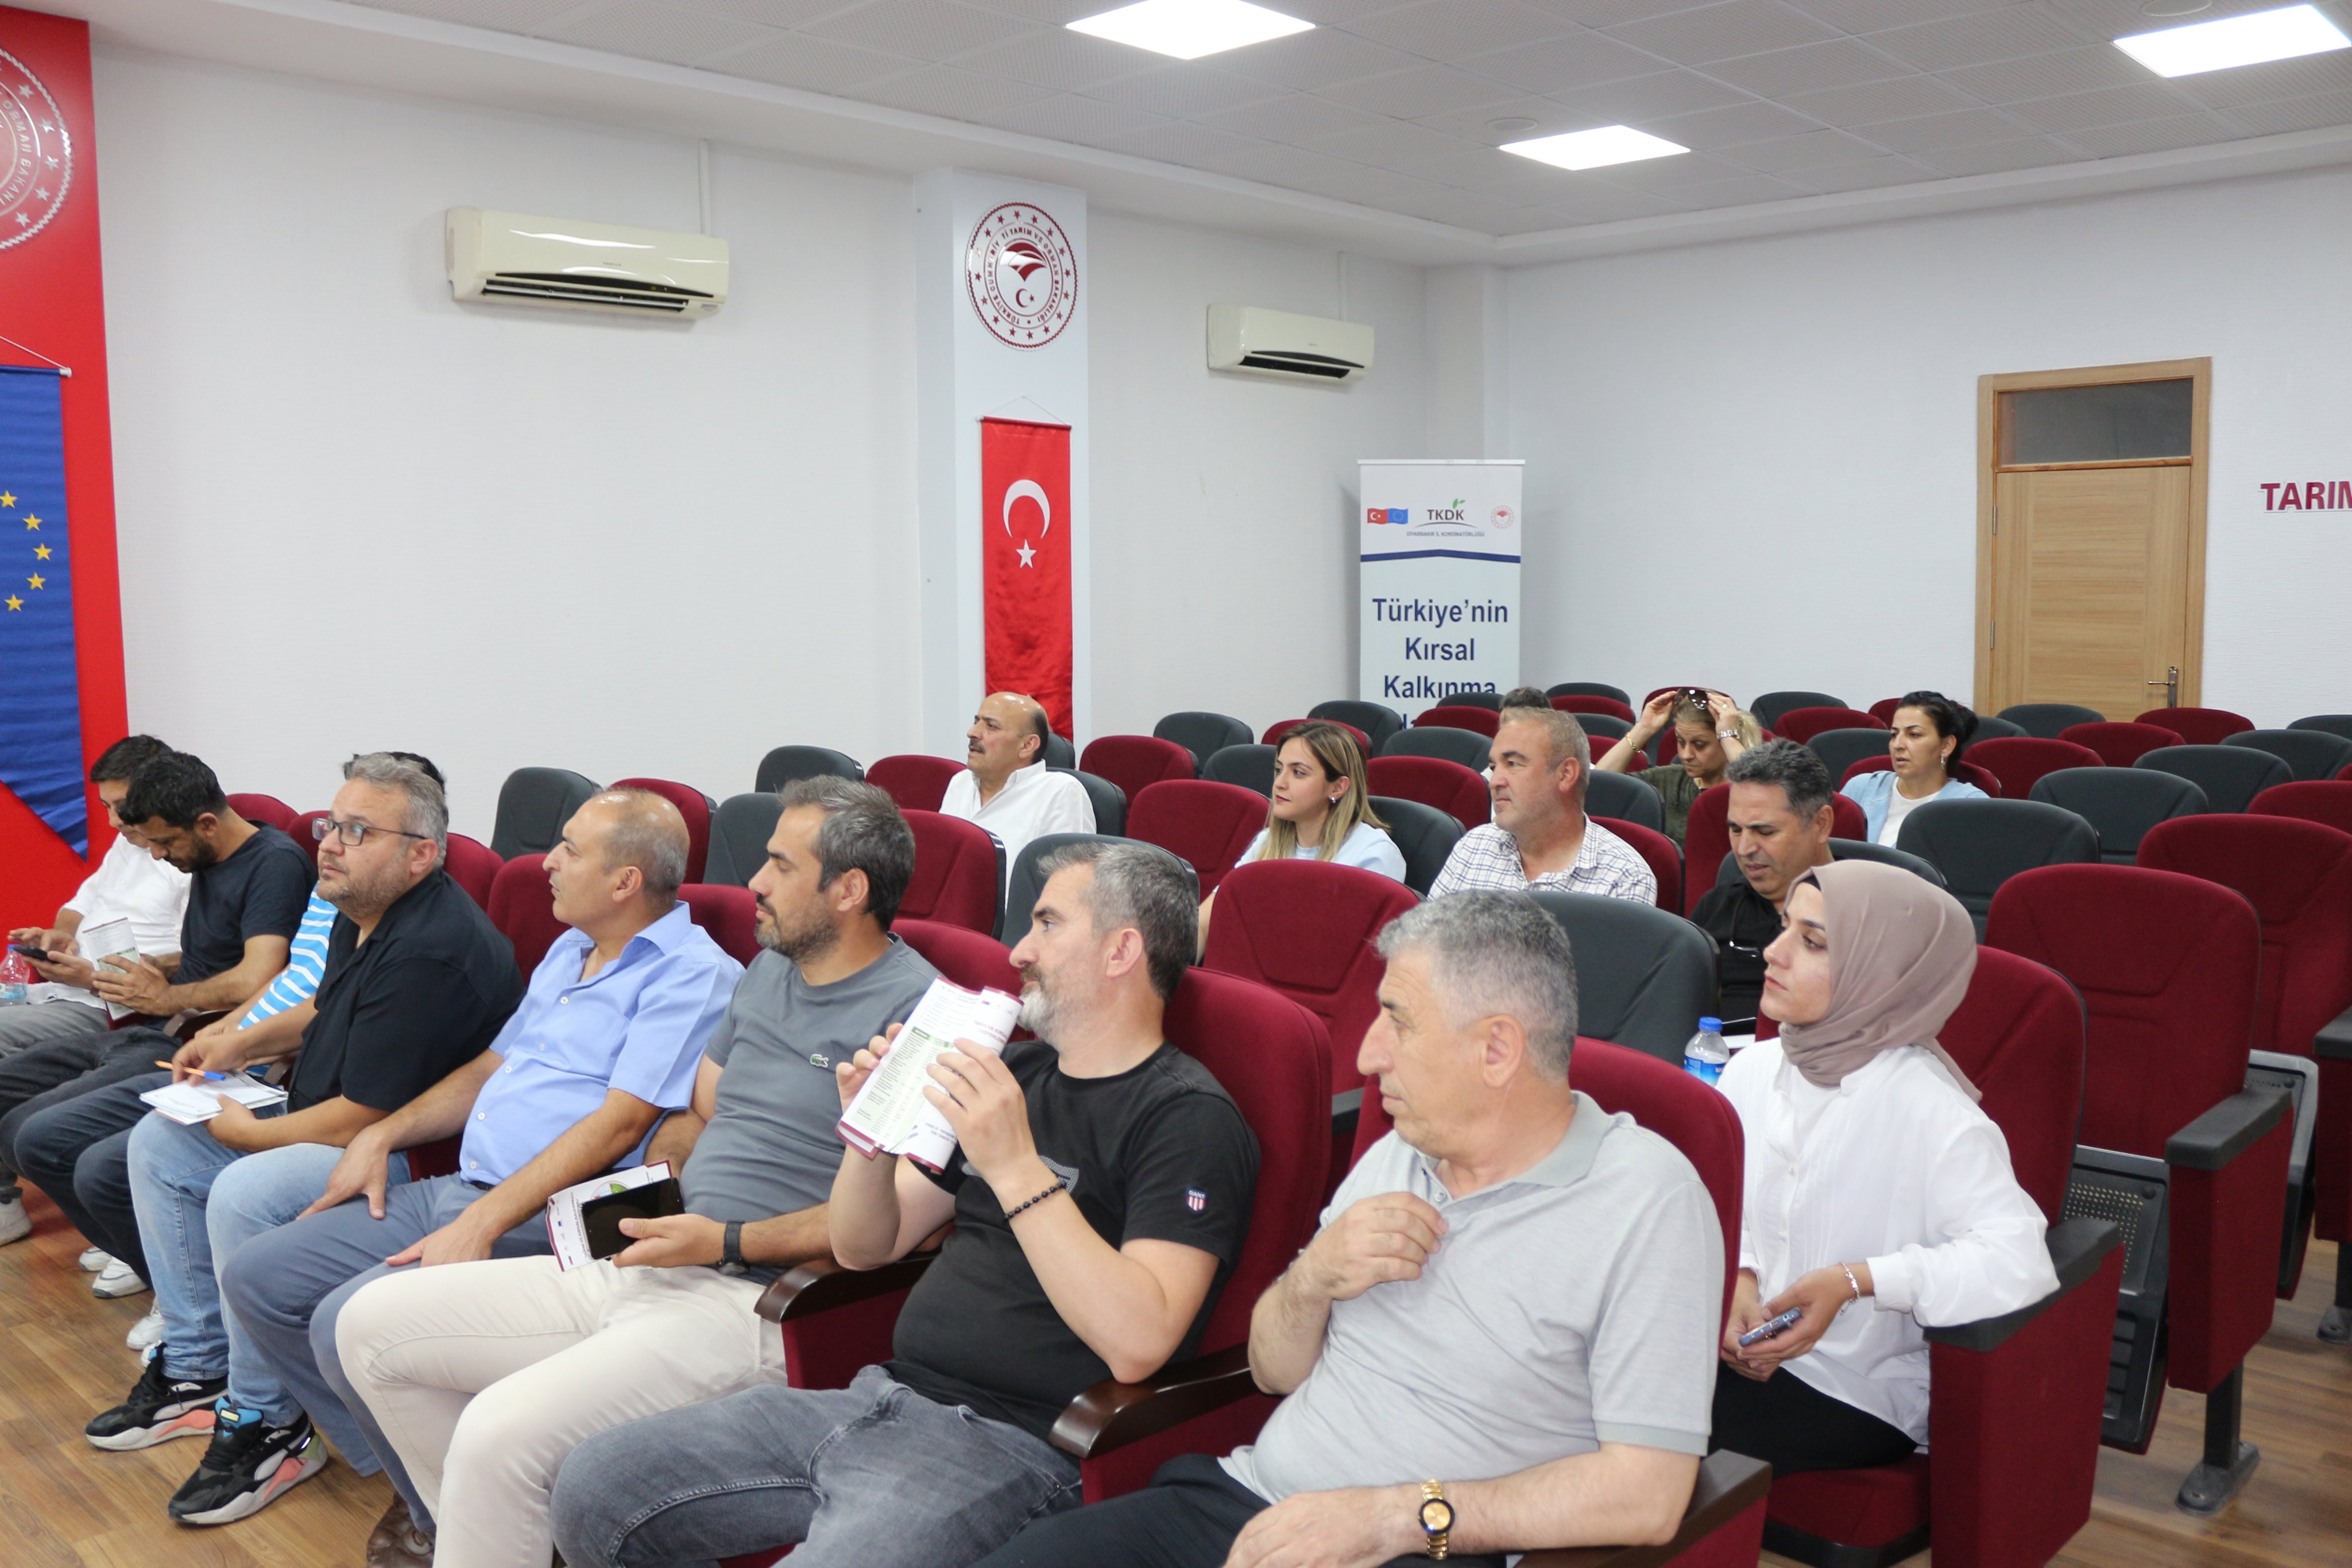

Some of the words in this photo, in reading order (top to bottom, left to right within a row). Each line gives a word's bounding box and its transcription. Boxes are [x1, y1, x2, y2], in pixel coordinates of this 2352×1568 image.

[3, 100, 32, 153] ORMAN
[1009, 227, 1032, 237] TARIM
[1034, 232, 1043, 243] VE
[987, 230, 1009, 292] CUMHURİYTİ
[1043, 243, 1059, 276] ORMAN
[993, 294, 1020, 326] TÜRKİYE
[1036, 279, 1059, 323] BAKANLIĞI
[1426, 509, 1464, 521] TKDK
[1405, 637, 1475, 661] Kırsal
[1384, 675, 1496, 698] Kalkınma
[1189, 1190, 1205, 1199] GANT
